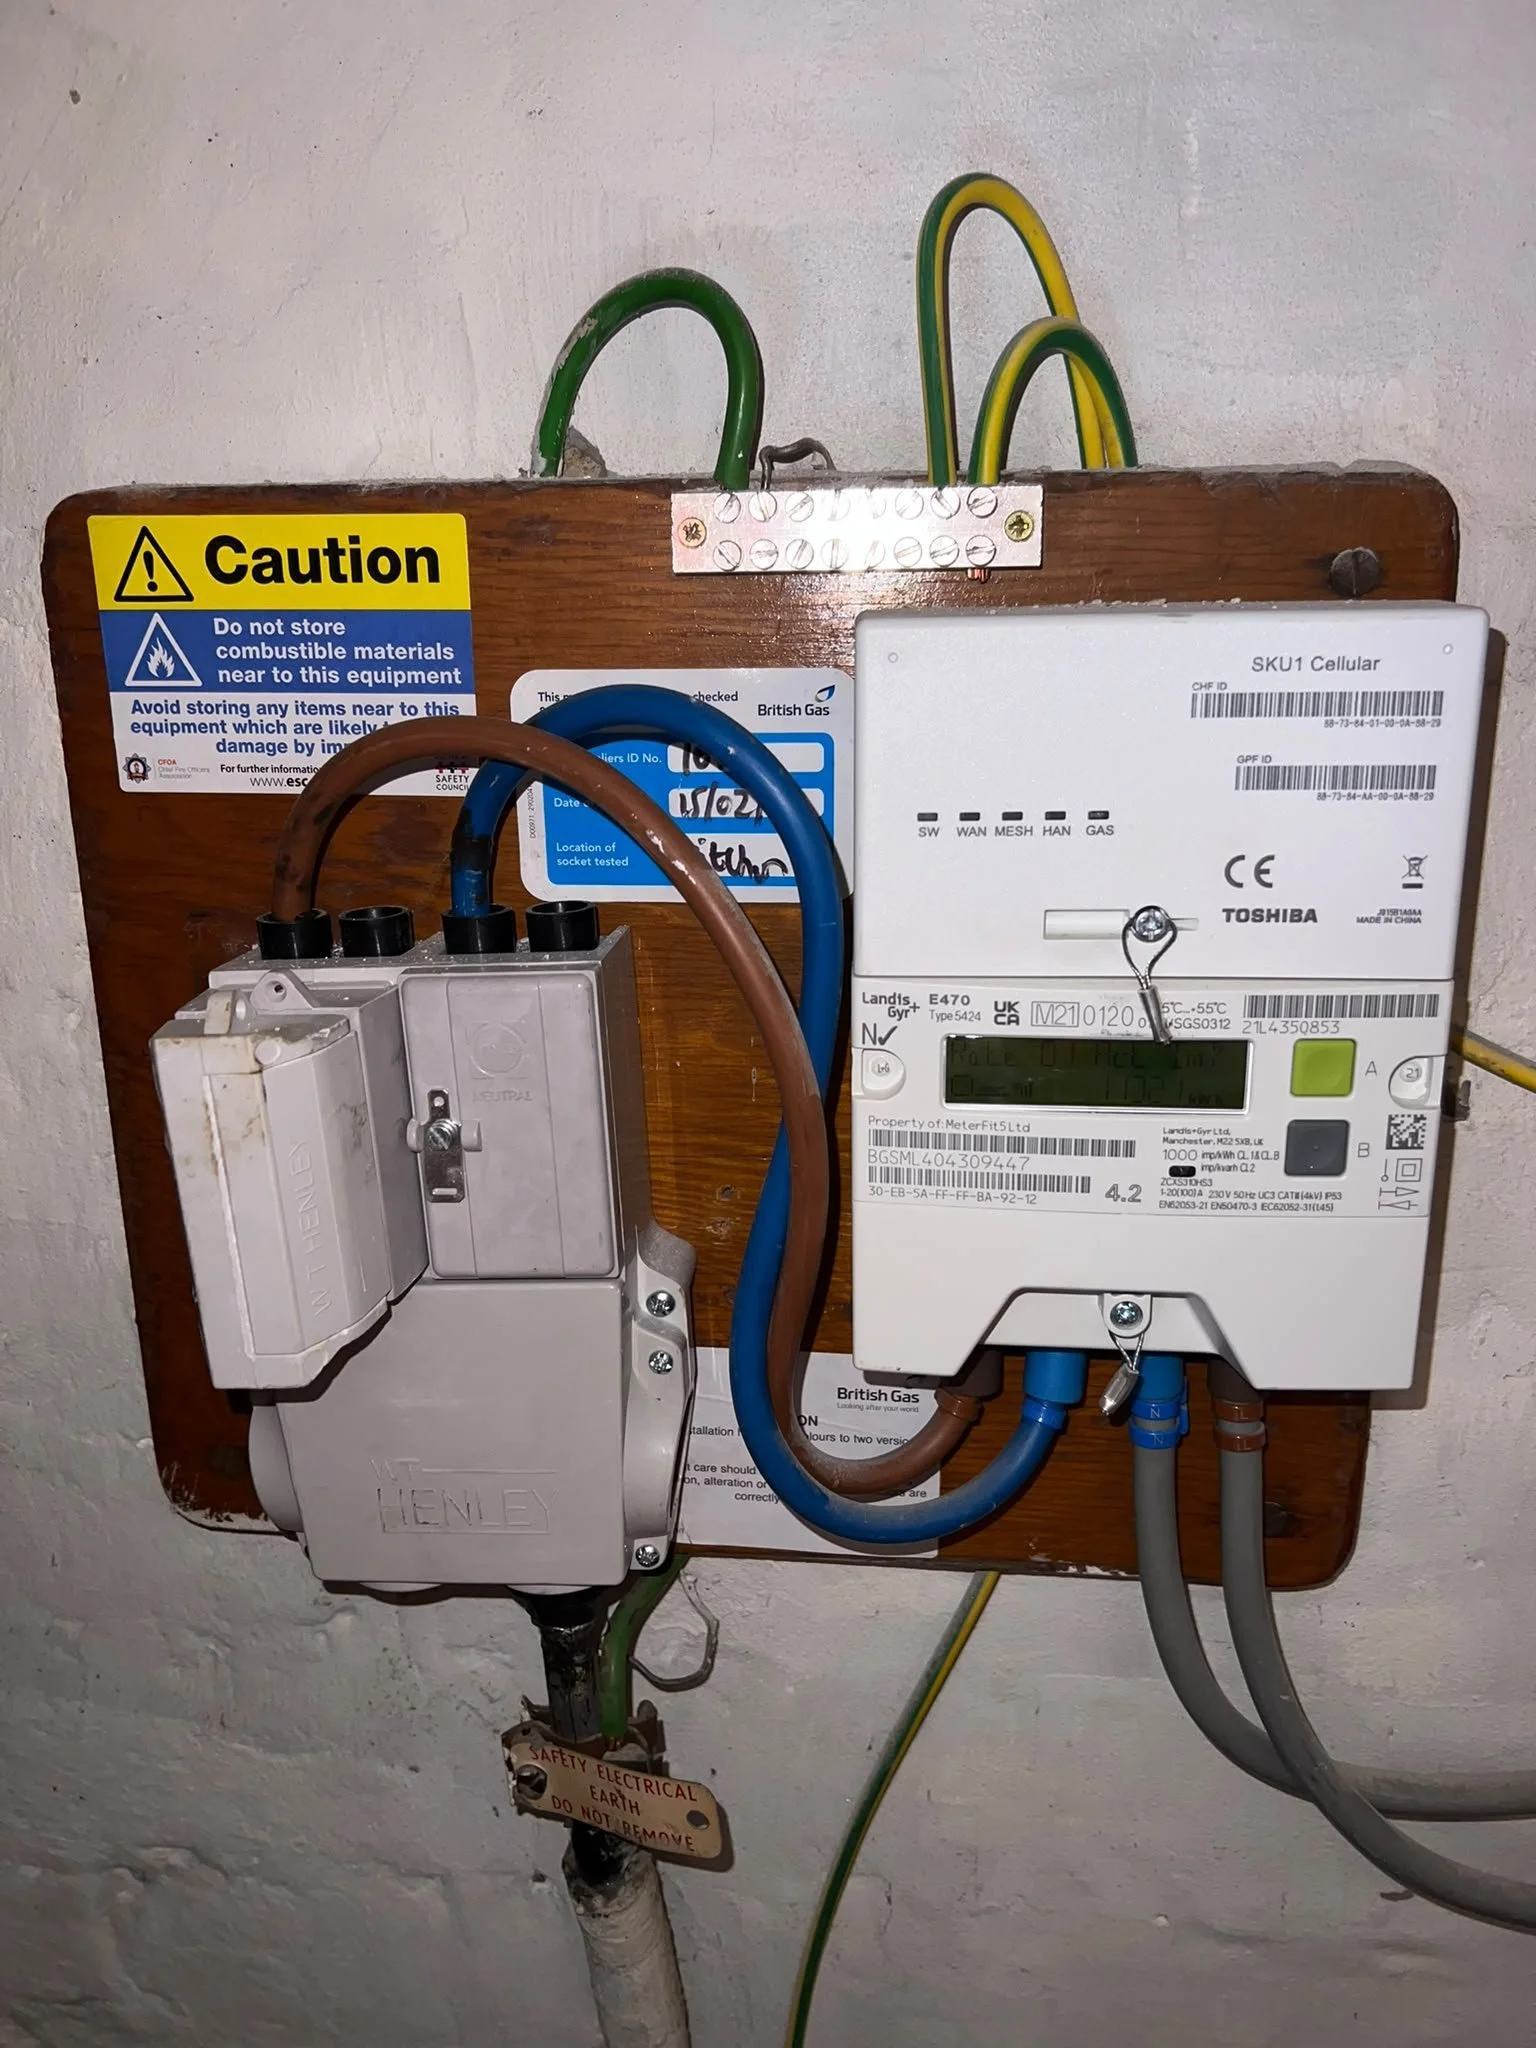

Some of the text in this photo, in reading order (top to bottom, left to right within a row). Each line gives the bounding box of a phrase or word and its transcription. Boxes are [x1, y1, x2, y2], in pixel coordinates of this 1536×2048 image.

[205, 534, 440, 584] Caution
[213, 617, 346, 635] Do not store
[216, 642, 454, 661] combustible materials
[1252, 655, 1381, 672] SKU1 Cellular
[218, 666, 461, 687] near to this equipment
[1192, 682, 1228, 691] CHF ID
[537, 691, 560, 702] This
[693, 691, 738, 702] checked
[131, 699, 459, 719] Avoid storing any items near to this
[758, 704, 830, 716] British Gas
[131, 719, 228, 737] equipment
[232, 719, 287, 735] which
[293, 722, 323, 735] are
[216, 738, 288, 756] damage
[294, 738, 316, 756] by
[598, 753, 662, 763] liers ID No.
[1237, 755, 1272, 764] GPF ID
[220, 764, 323, 775] For further informatio
[436, 774, 469, 783] SAFETY
[554, 797, 580, 808] Date
[918, 825, 1115, 837] SW WAN MESH HAN GAS
[556, 841, 617, 852] Location of
[557, 856, 629, 867] socket tested
[1222, 907, 1318, 923] TOSHIBA
[1356, 916, 1382, 925] MADE
[1395, 916, 1423, 925] CHINA
[862, 992, 971, 1006] Landis E470
[929, 1009, 981, 1023] Type 5424
[994, 1001, 1020, 1013] UK
[1034, 1003, 1076, 1026] M21
[1083, 1004, 1135, 1027] 0120
[994, 1014, 1020, 1026] CA
[1365, 1060, 1377, 1076] A
[1406, 1067, 1420, 1079] 21
[868, 1115, 924, 1130] Property
[1163, 1127, 1212, 1136] Landis+Gyr
[1163, 1149, 1198, 1161] 1000
[1201, 1151, 1236, 1162] imp/kWh
[1358, 1142, 1370, 1158] B
[868, 1149, 1030, 1171] BGSML404309447
[288, 1138, 323, 1256] HENLEY
[868, 1185, 1038, 1205] 30-EB-5A-FF-FF-BA-92-12
[1105, 1184, 1143, 1203] 4.2
[837, 1387, 920, 1404] British Gas
[840, 1434, 850, 1442] to
[854, 1434, 873, 1445] two
[693, 1463, 717, 1473] care
[720, 1464, 757, 1475] should
[703, 1477, 753, 1489] alteration
[756, 1479, 767, 1489] or
[734, 1493, 780, 1505] correctly
[908, 1489, 928, 1498] are
[376, 1486, 561, 1531] HENLEY
[529, 1745, 698, 1802] SAFETY ELECTRICAL
[590, 1785, 641, 1817] EARTH
[551, 1795, 696, 1852] DO NOT REMOVE
